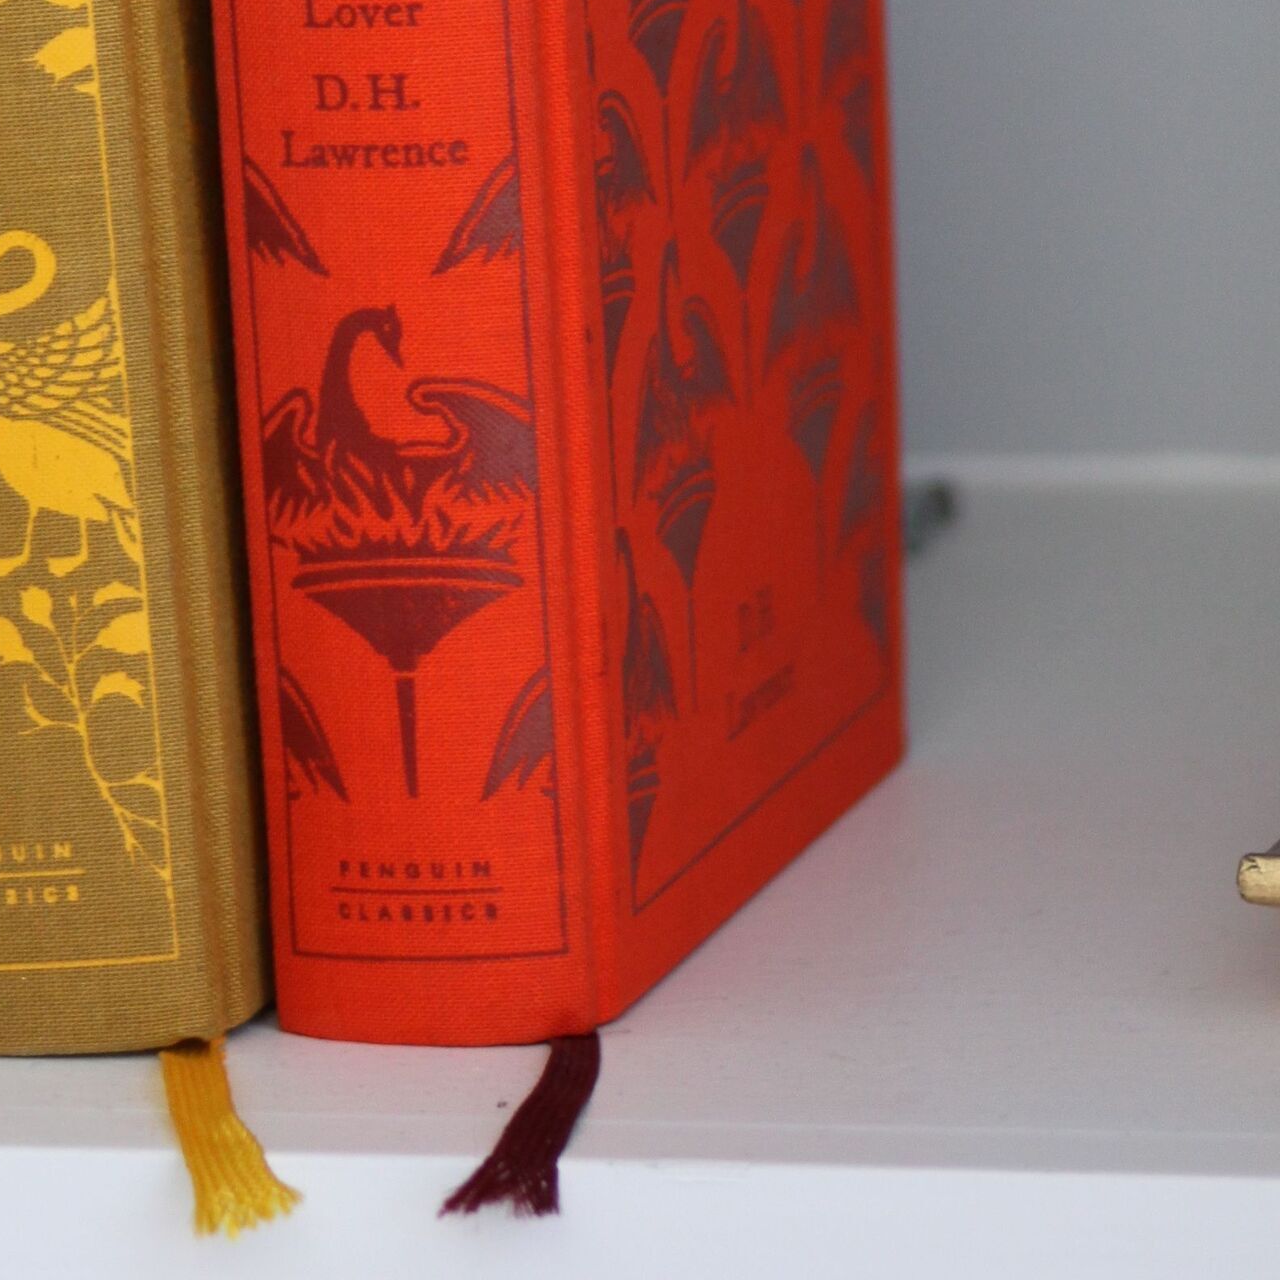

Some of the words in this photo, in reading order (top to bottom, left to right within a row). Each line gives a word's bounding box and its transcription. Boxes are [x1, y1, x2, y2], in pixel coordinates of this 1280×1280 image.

[280, 129, 471, 169] Lawrence
[338, 859, 491, 880] PENGUIN
[337, 902, 499, 922] CLASSICS
